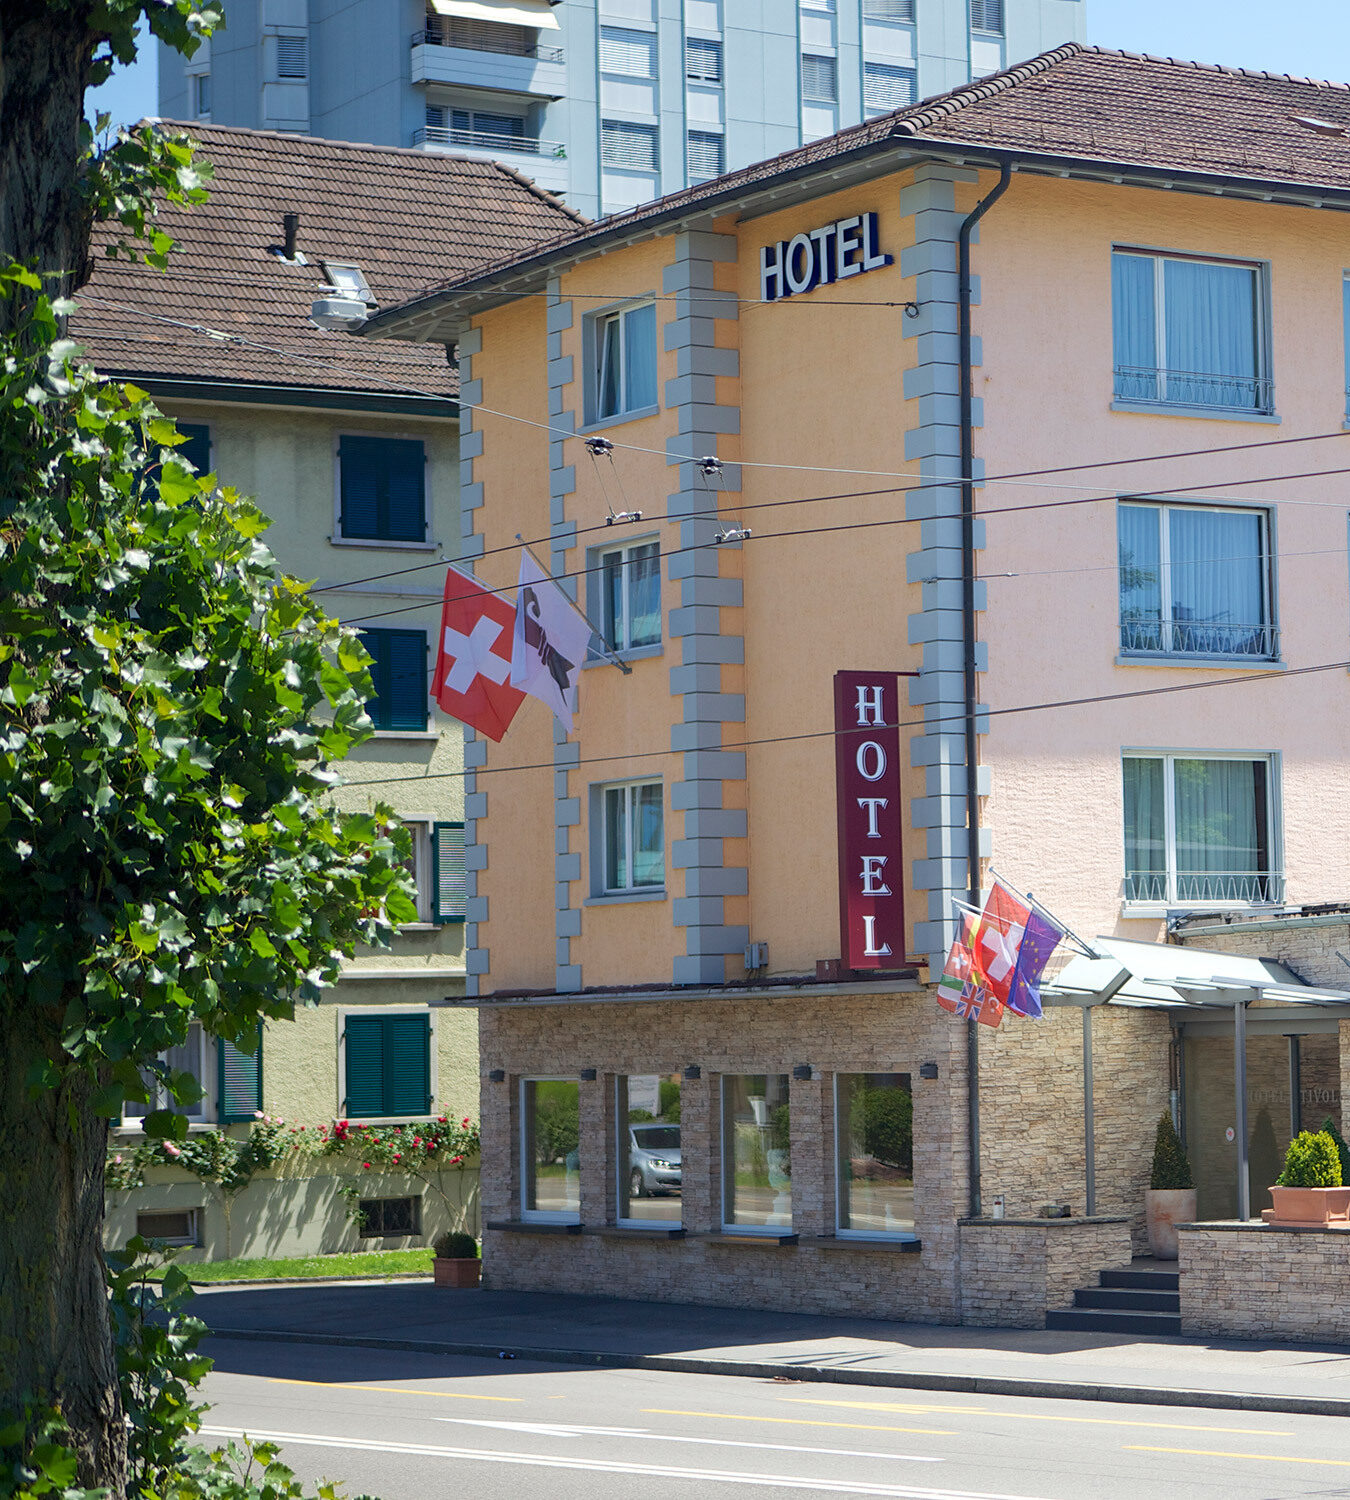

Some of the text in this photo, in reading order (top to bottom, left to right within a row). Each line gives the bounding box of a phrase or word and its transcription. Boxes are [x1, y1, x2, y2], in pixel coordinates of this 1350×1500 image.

[760, 212, 892, 302] HOTEL
[854, 685, 893, 957] HOTEL
[1301, 1088, 1338, 1104] TIVOL
